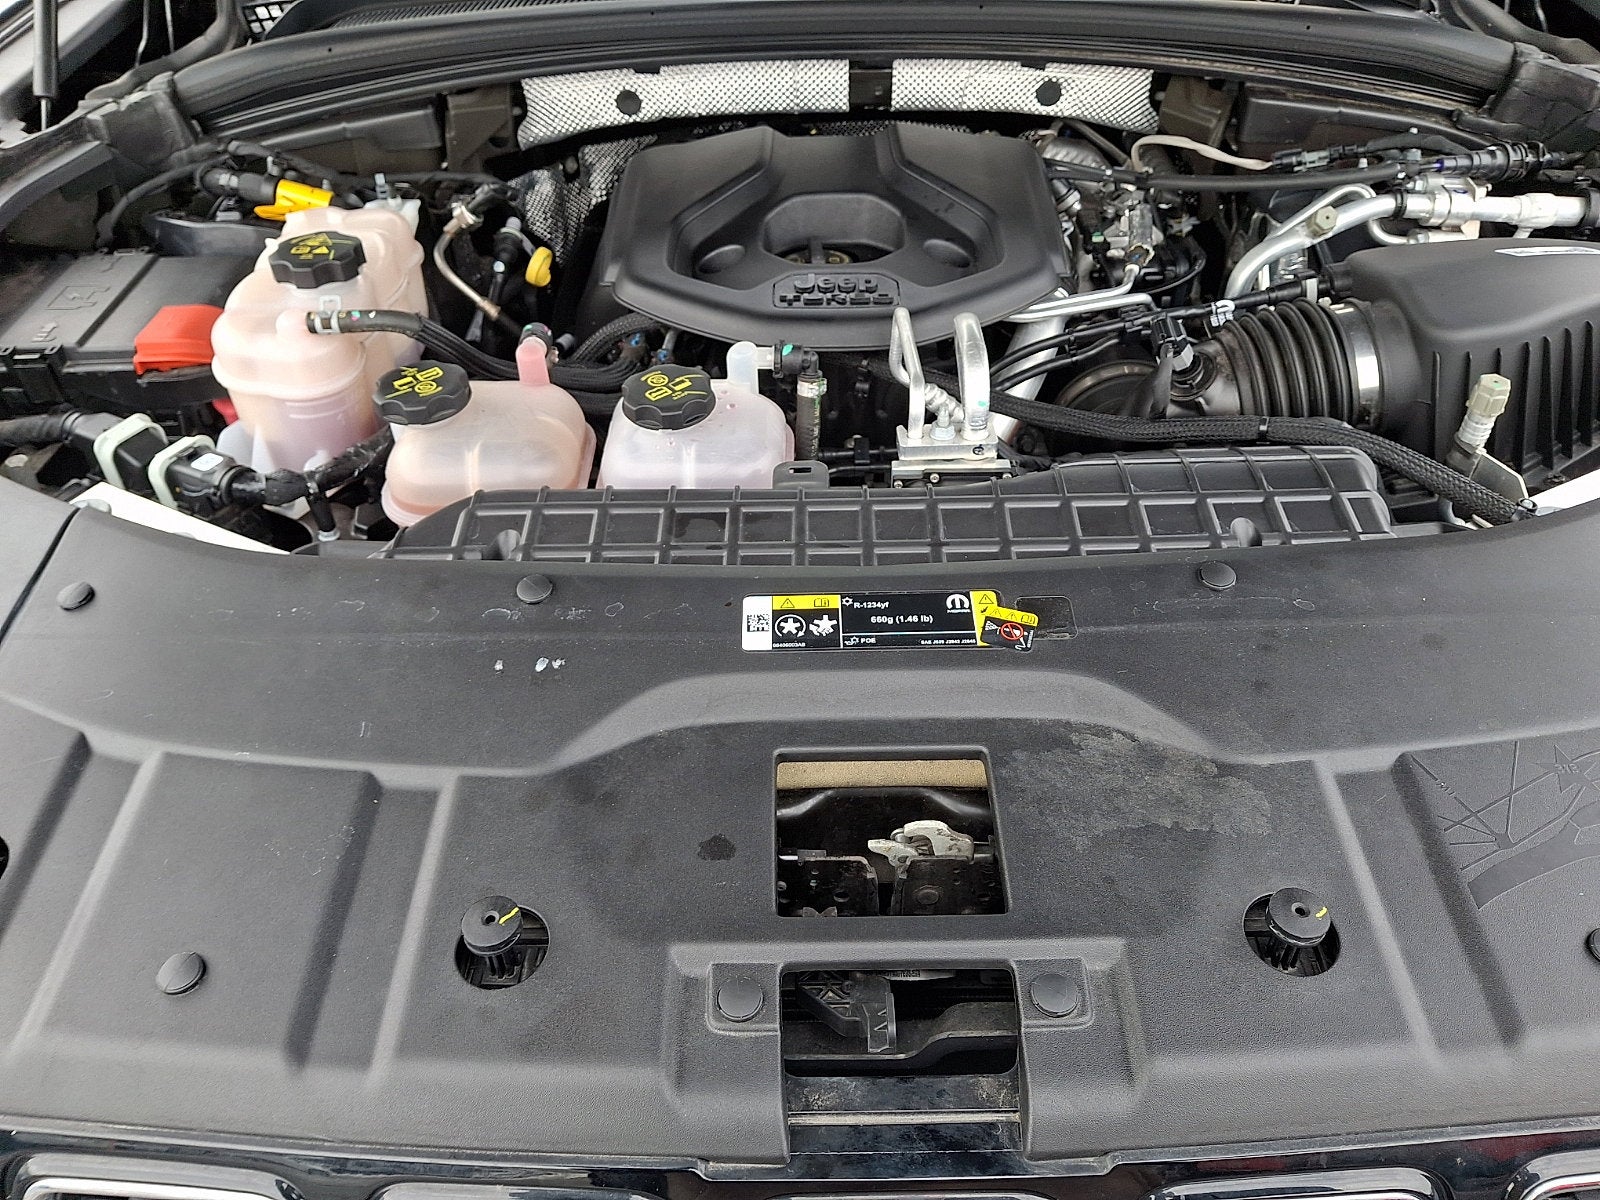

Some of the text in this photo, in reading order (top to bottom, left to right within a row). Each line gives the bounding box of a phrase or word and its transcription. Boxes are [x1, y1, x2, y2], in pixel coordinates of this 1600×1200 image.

[793, 273, 878, 293] Jeep
[853, 601, 890, 610] R-1234yf
[870, 614, 934, 625] 660g (1.46 lb)
